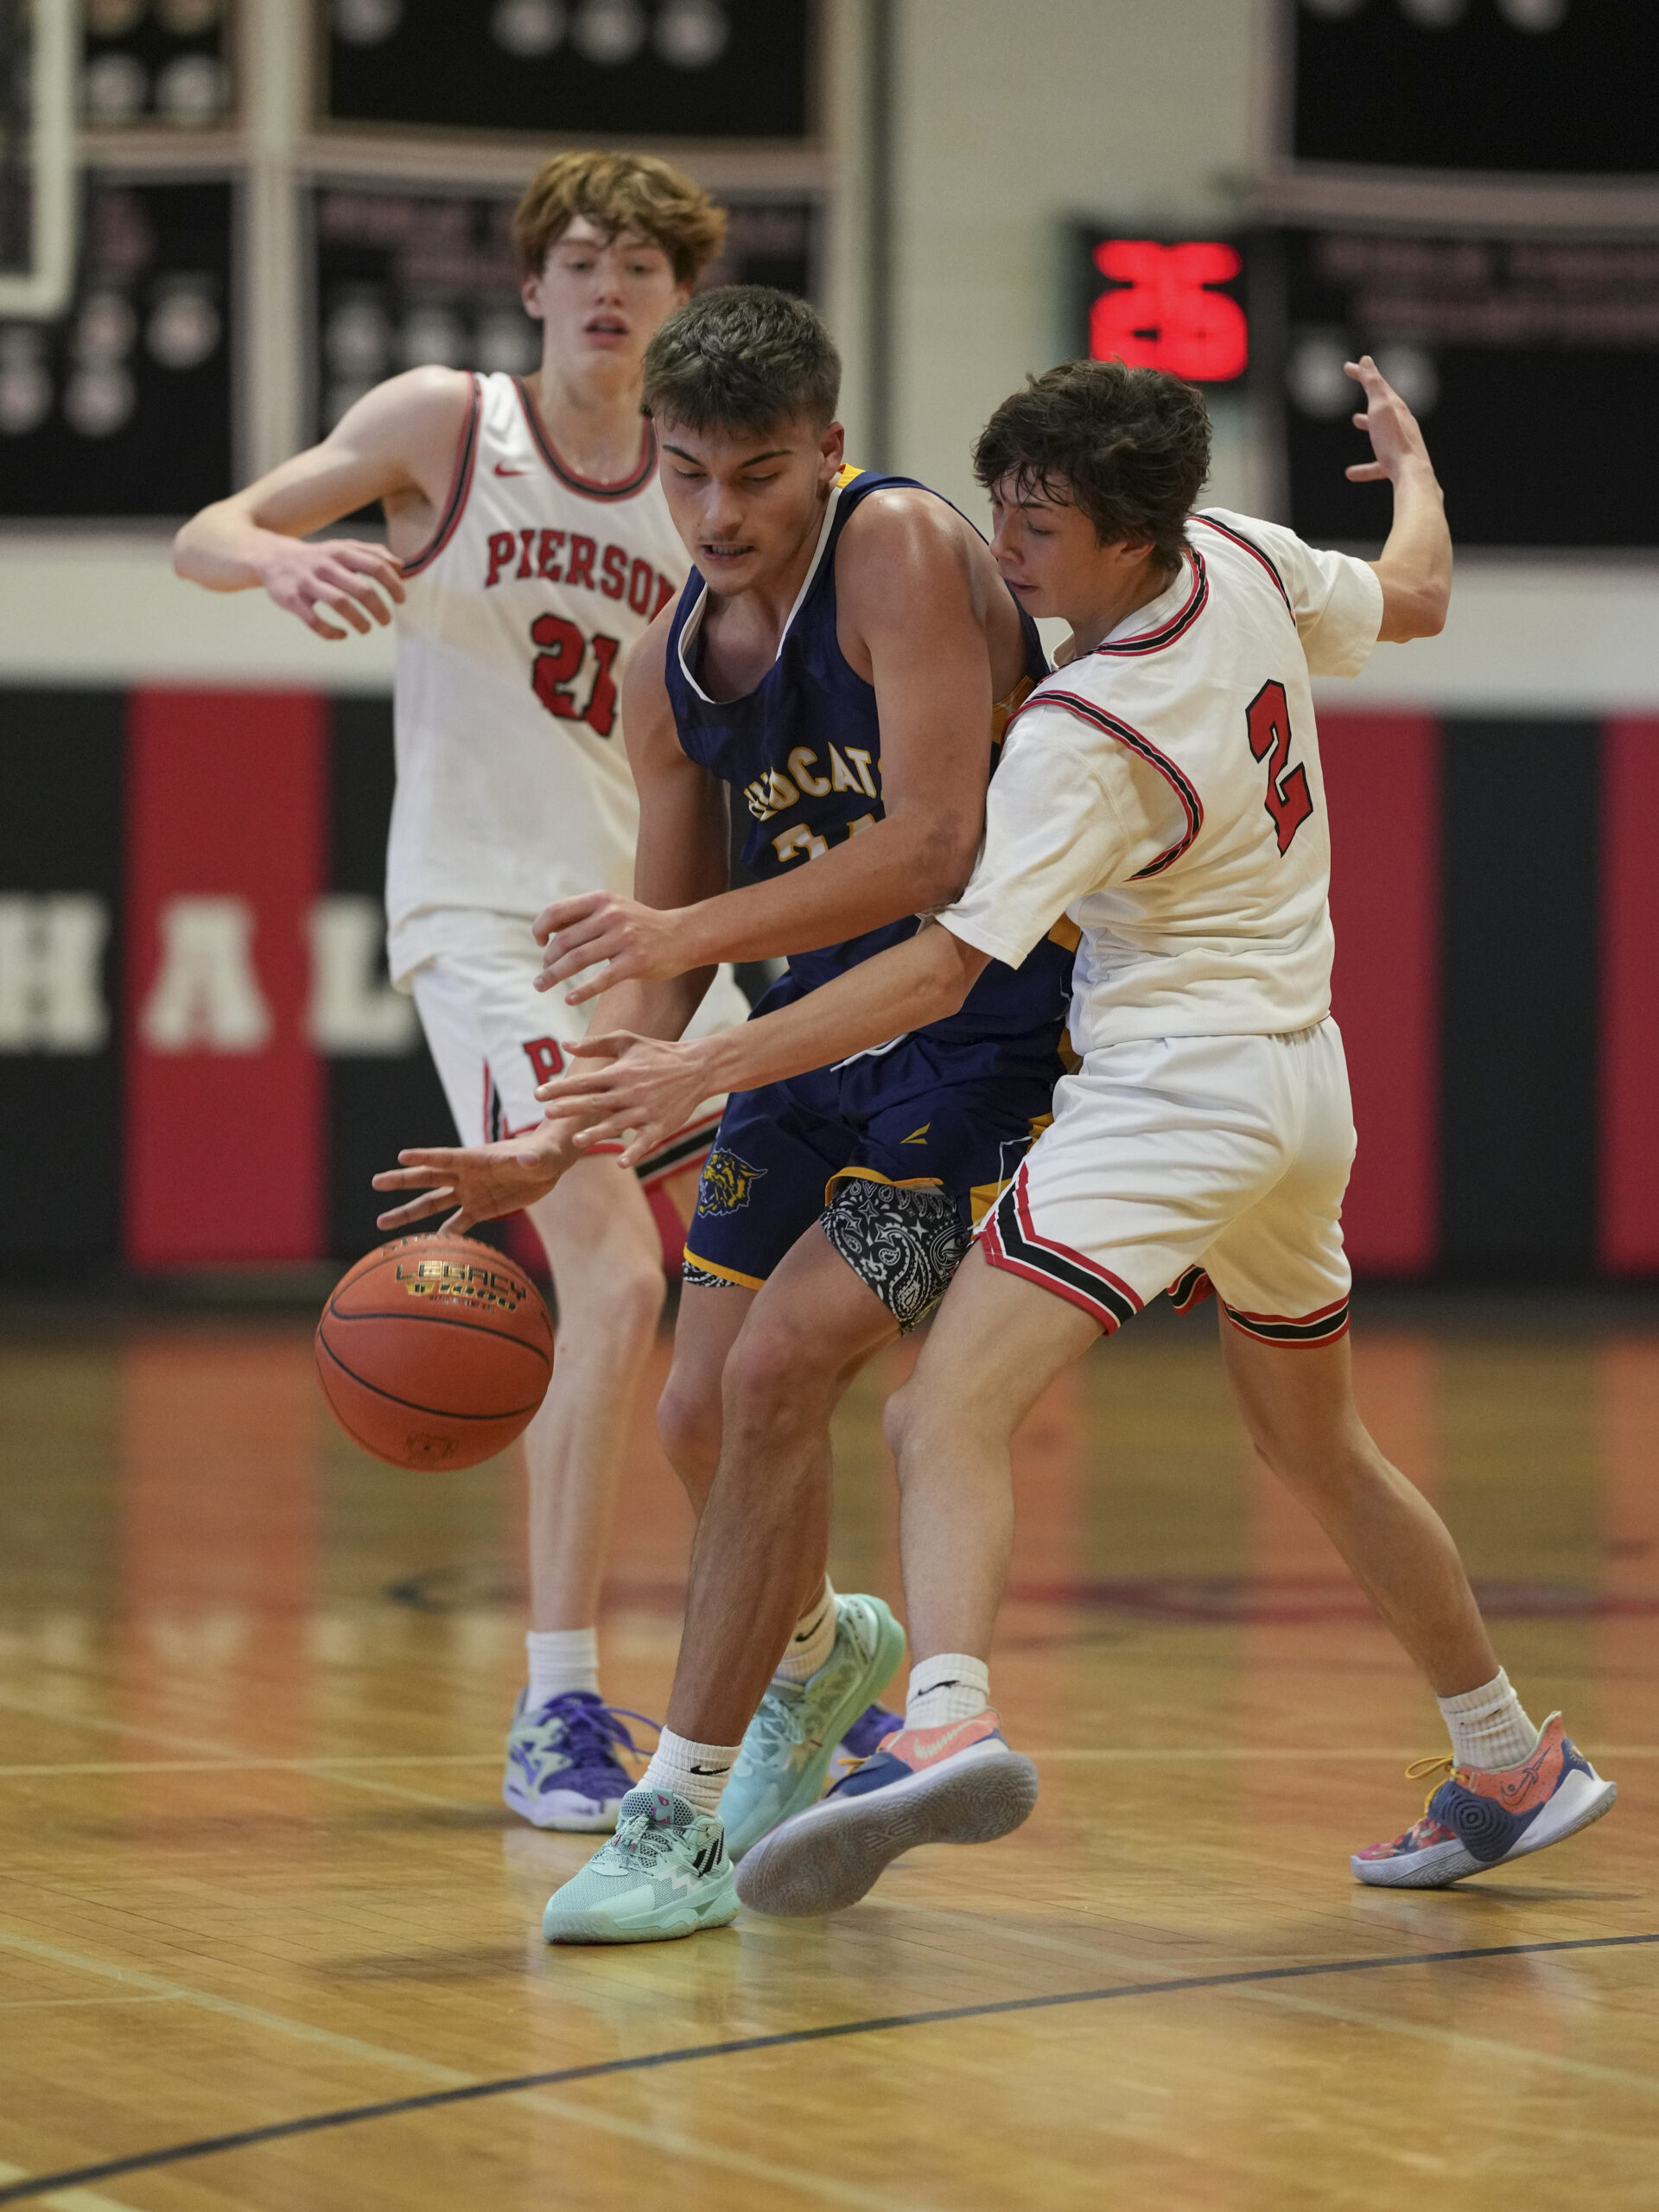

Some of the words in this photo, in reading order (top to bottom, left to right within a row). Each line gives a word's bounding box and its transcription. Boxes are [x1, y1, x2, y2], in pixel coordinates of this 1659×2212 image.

[531, 611, 620, 740] 21
[1244, 678, 1314, 859] 2
[395, 1260, 526, 1301] LEGACY
